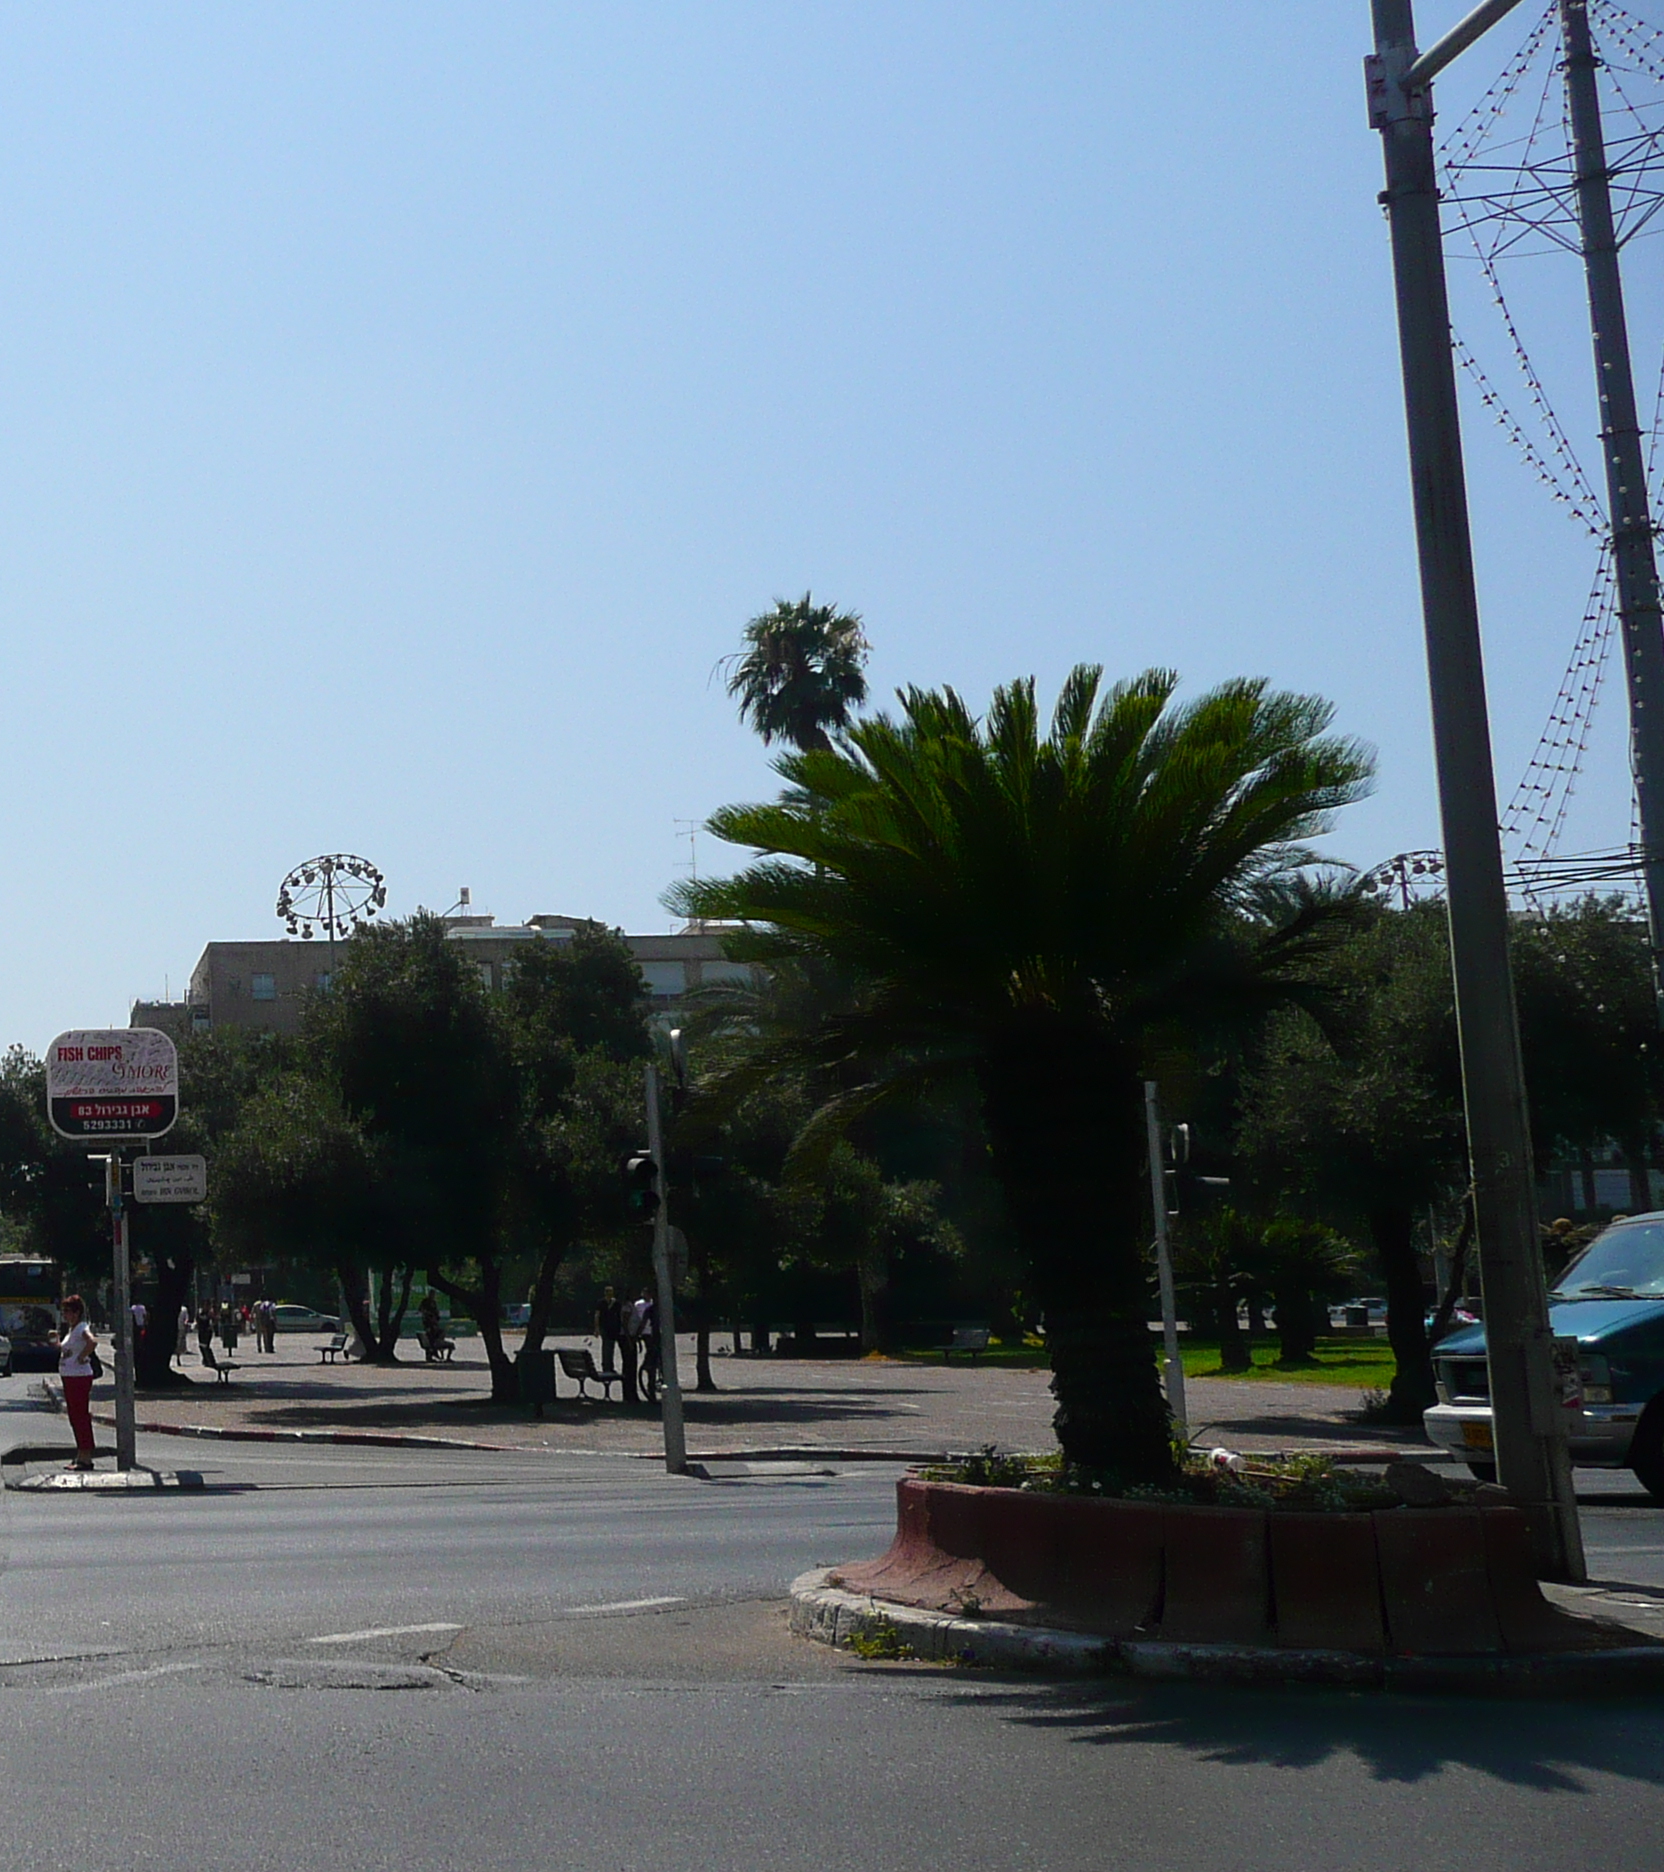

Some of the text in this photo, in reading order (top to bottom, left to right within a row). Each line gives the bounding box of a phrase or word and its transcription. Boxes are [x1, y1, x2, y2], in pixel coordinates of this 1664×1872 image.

[57, 1045, 123, 1061] FISH CHIPS
[94, 1103, 128, 1116] גבירול
[131, 1104, 150, 1117] אבן
